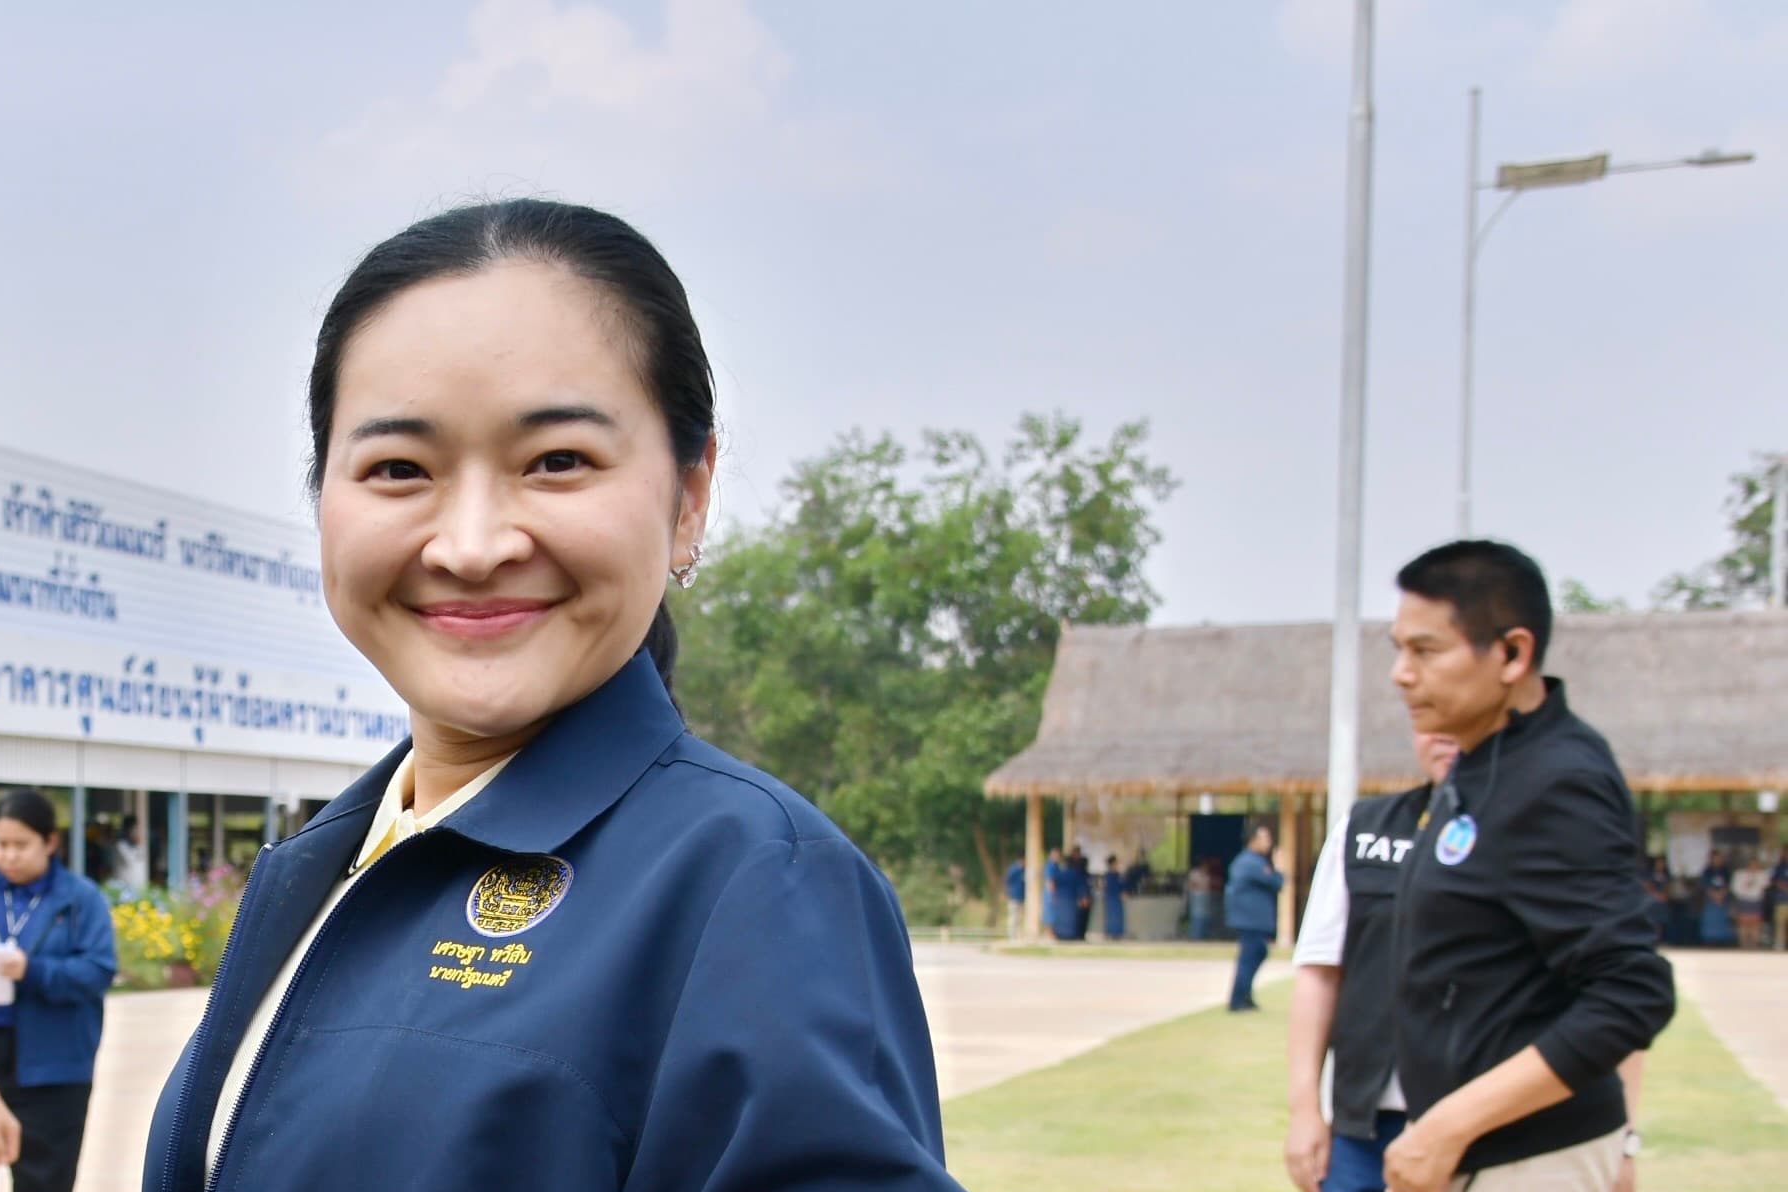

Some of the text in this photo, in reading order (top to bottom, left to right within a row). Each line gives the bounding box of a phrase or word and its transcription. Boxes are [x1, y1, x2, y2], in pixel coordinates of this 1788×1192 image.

[1355, 832, 1415, 864] TAT
[432, 940, 532, 966] เศรษฐา ทวีสิน
[429, 965, 513, 990] นายกรัฐมนตรี
